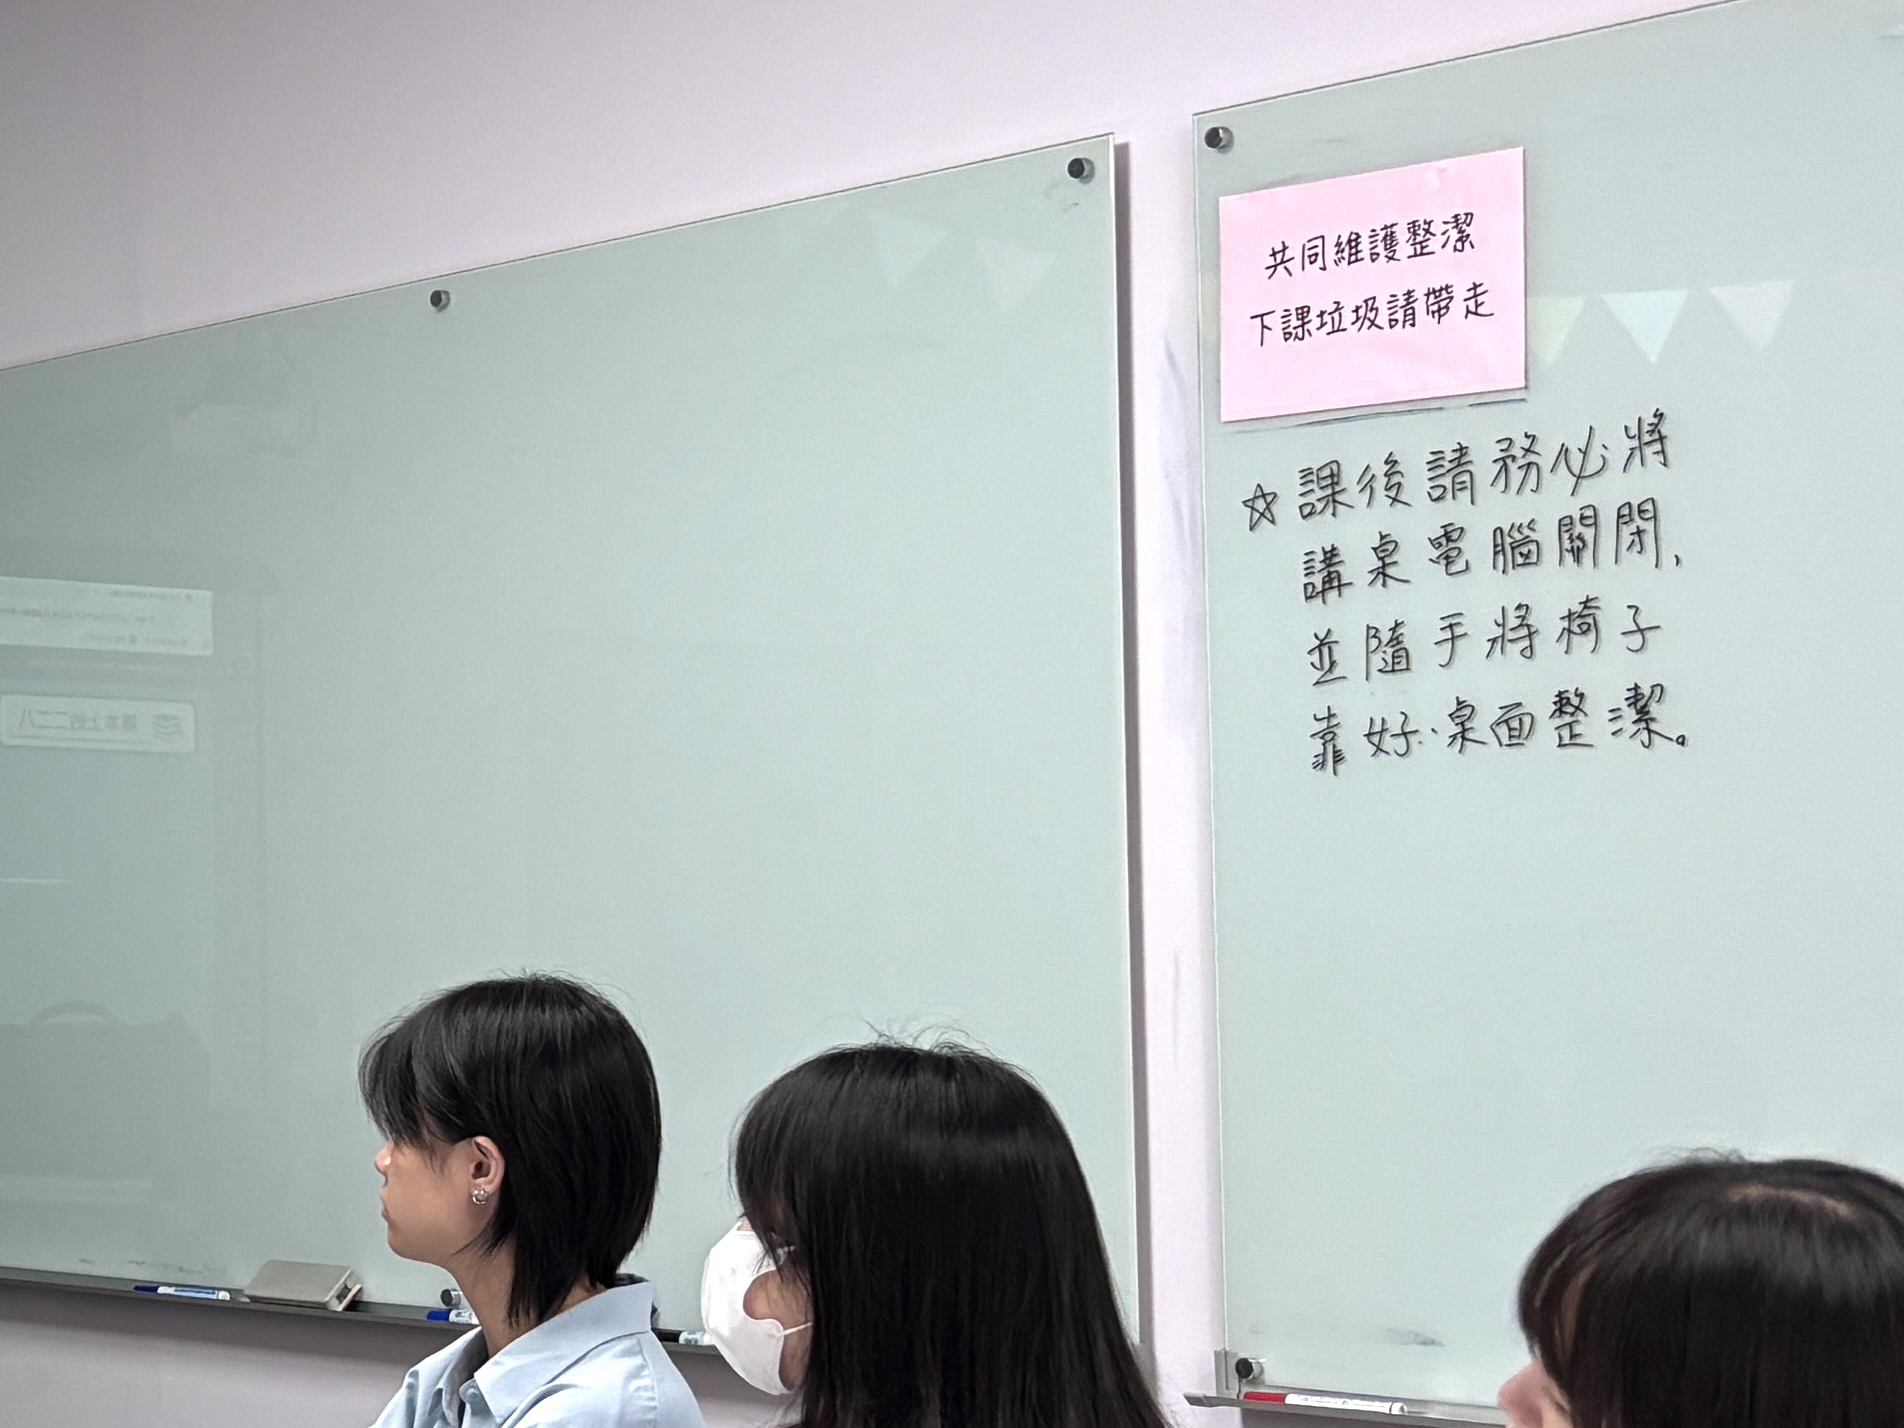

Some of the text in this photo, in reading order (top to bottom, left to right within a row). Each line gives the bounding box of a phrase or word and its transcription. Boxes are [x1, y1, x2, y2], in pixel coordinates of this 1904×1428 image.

[1264, 212, 1476, 281] 共同維護整潔
[1249, 282, 1495, 348] 下課垃圾請帶走
[1296, 408, 1670, 522] 課後請務必將
[1307, 595, 1662, 686] 並隨手將椅子
